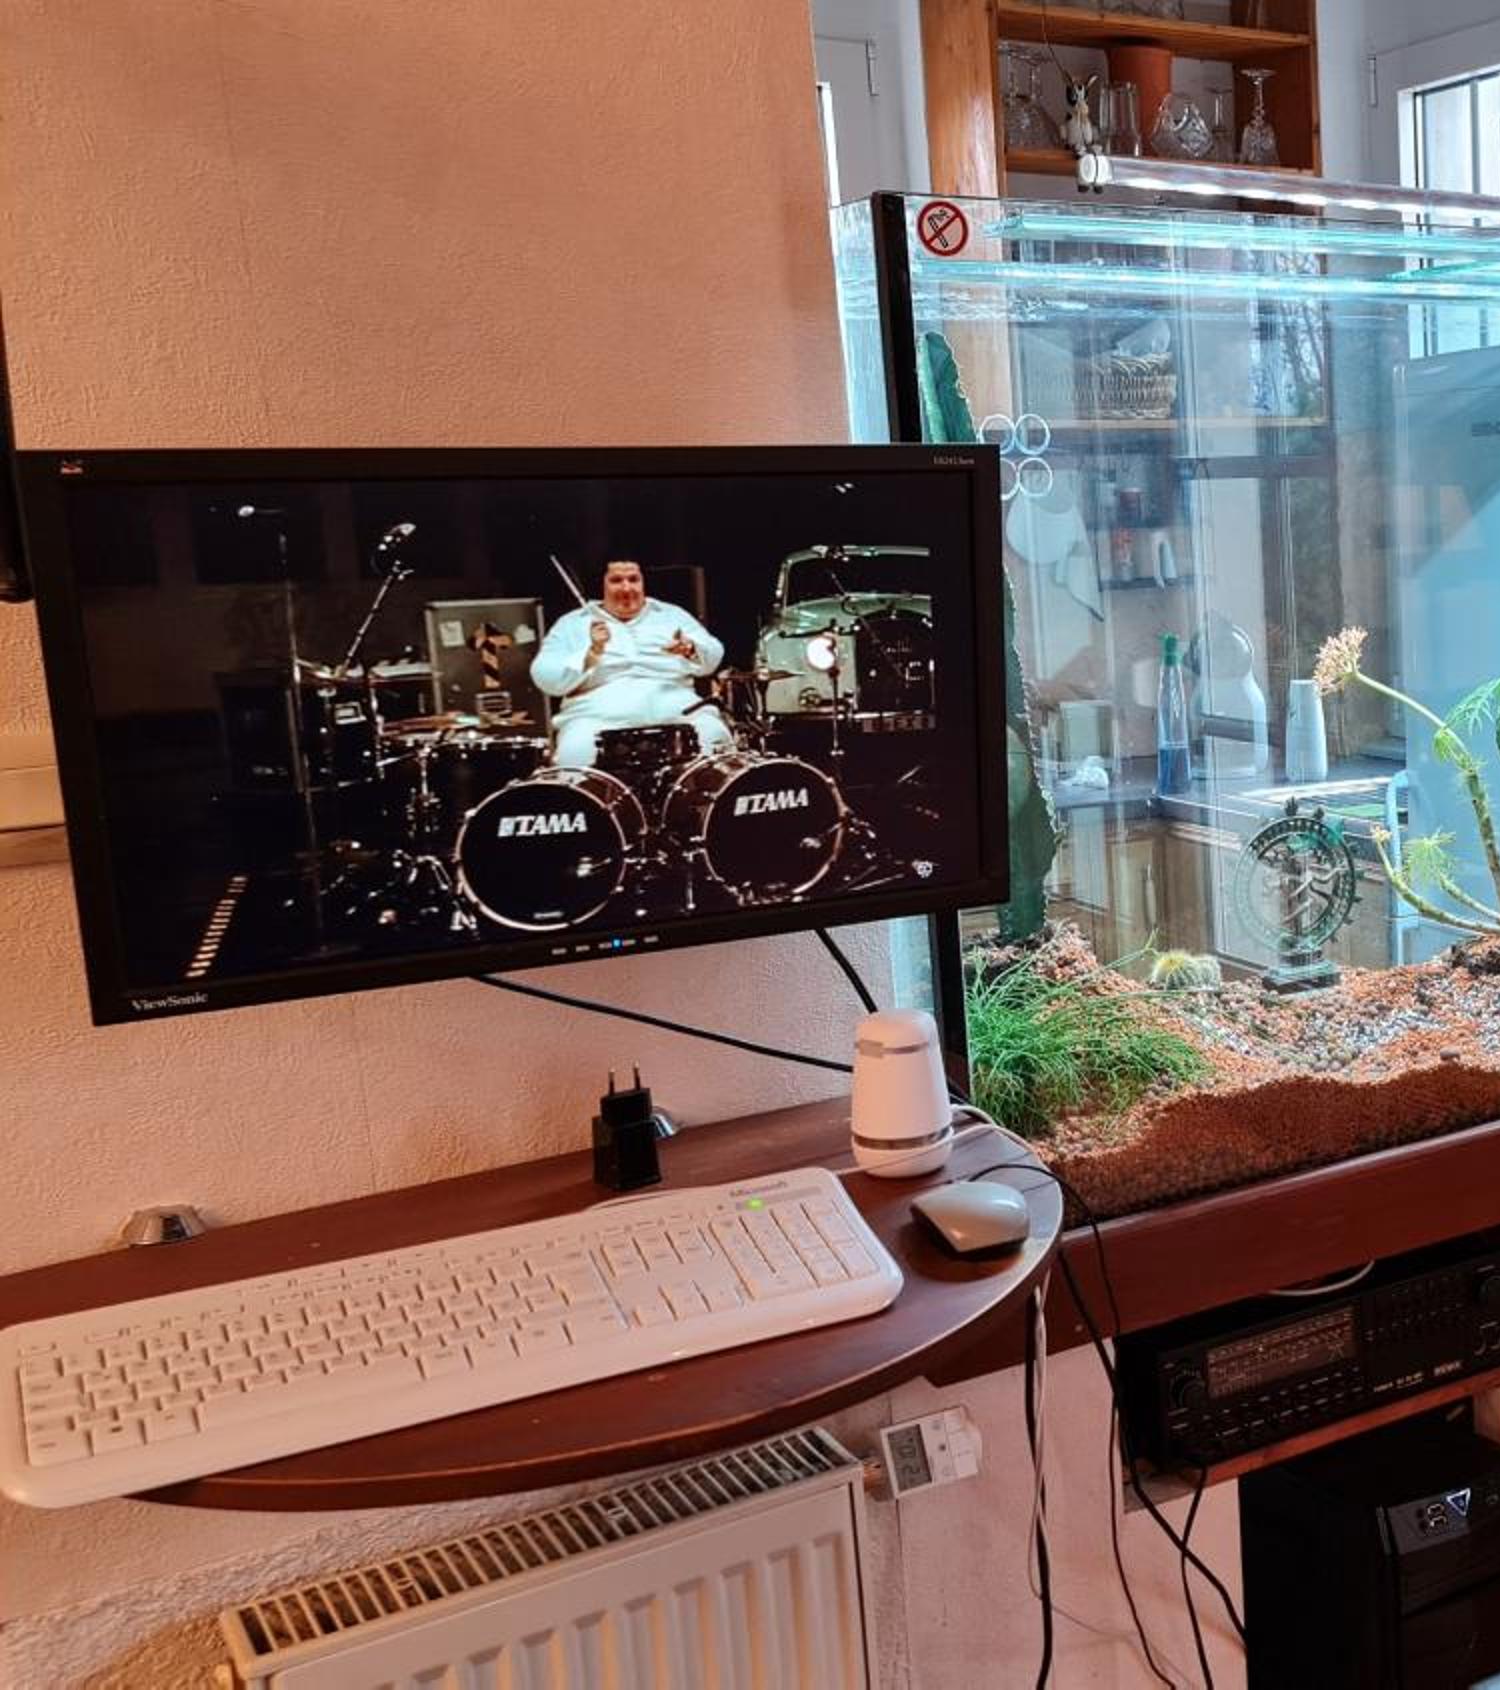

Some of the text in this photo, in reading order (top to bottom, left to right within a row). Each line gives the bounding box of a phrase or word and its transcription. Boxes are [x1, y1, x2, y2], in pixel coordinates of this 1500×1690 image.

[748, 787, 808, 813] TAMA
[515, 812, 587, 837] TAMA
[131, 992, 208, 1012] ViewSonic
